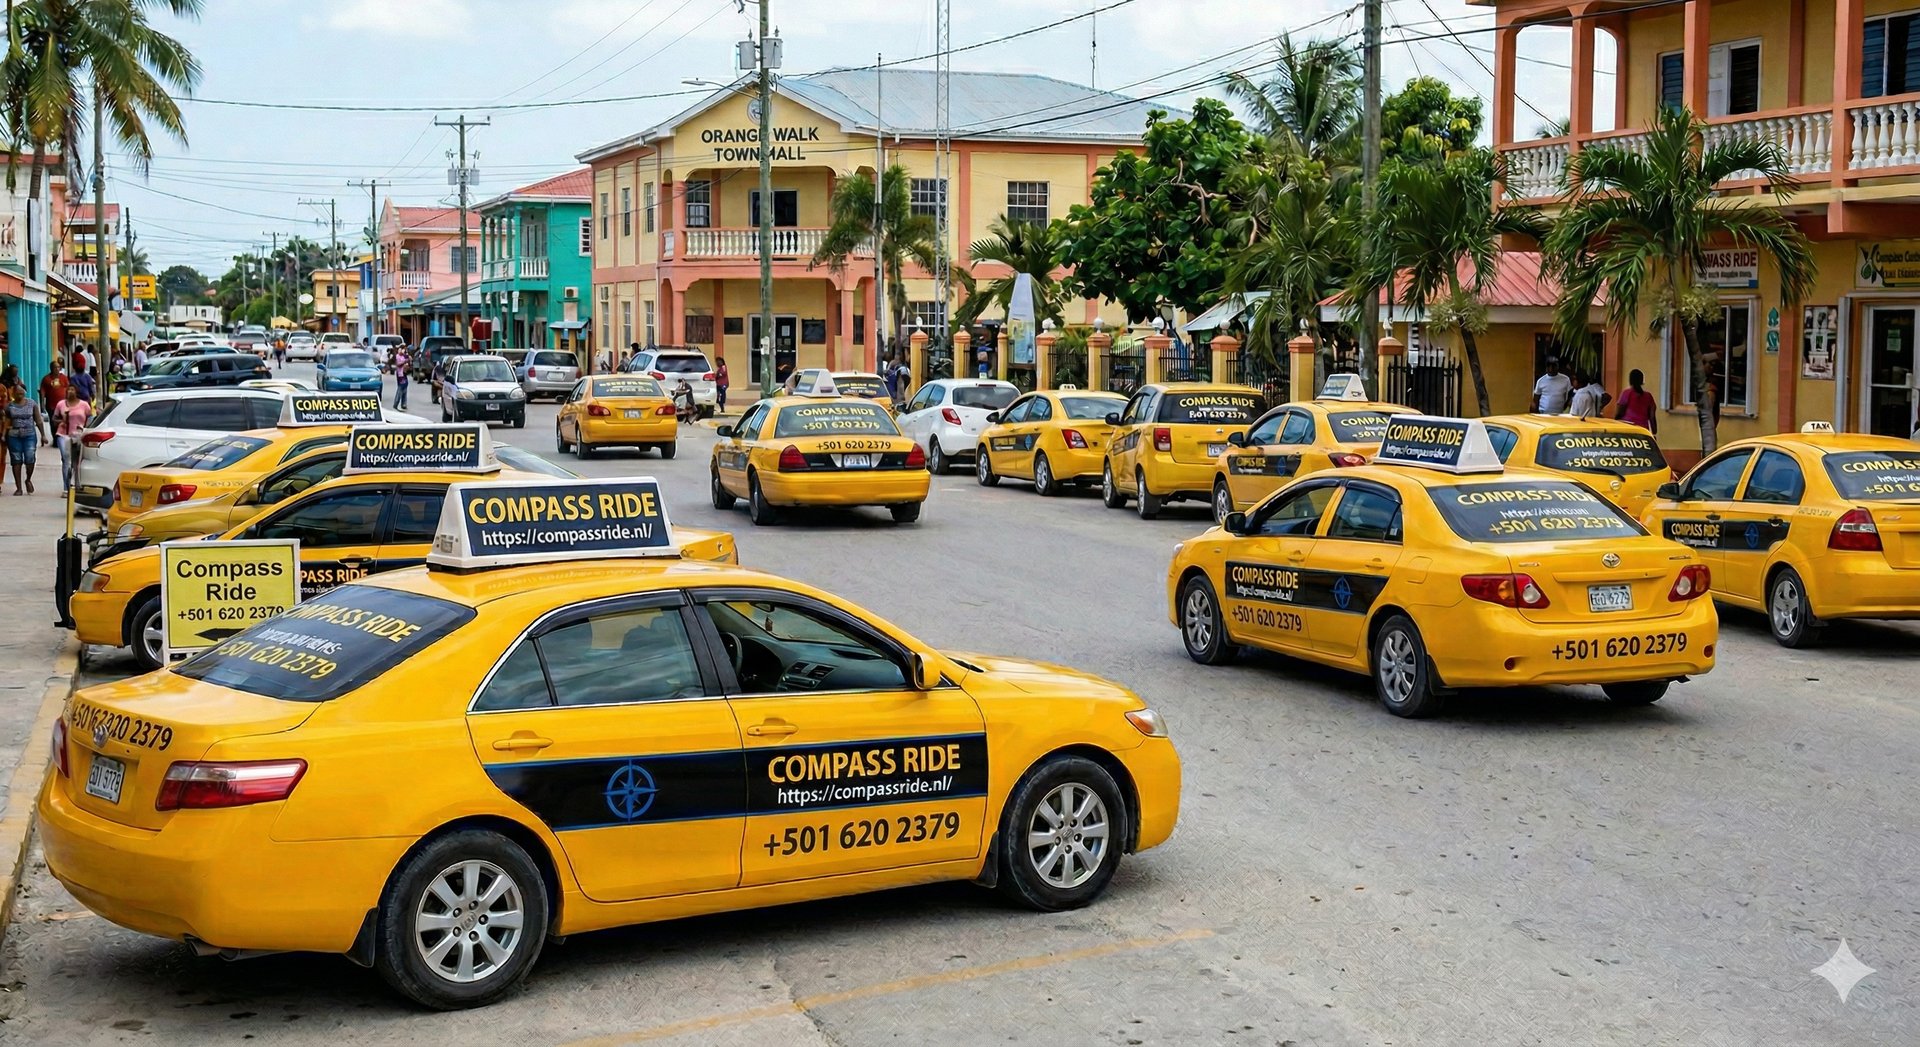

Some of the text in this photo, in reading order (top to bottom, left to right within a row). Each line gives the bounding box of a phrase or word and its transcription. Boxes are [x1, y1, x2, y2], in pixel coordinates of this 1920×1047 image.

[773, 127, 819, 141] WALK
[714, 147, 760, 162] TOWN
[1733, 252, 1757, 267] RIDE
[296, 399, 378, 411] COMPASS RIDE
[1180, 396, 1255, 408] COMPASS RIDE
[796, 407, 850, 417] COMPASS
[1209, 411, 1224, 419] 620
[802, 421, 828, 430] +501
[832, 421, 852, 429] 620
[355, 433, 475, 450] COMPASS RIDE
[1387, 424, 1464, 446] COMPASS RIDE
[1555, 437, 1651, 450] COMPASS RIDE
[816, 441, 891, 450] +501 620 2379
[360, 452, 470, 465] https://compassride.nl/
[1565, 458, 1652, 467] +501 620 2379
[1457, 490, 1552, 506] COMPASS
[468, 492, 658, 525] COMPASS RIDE
[1489, 517, 1624, 535] +501 620 2379
[482, 523, 652, 548] https://compassride.nl/
[177, 560, 283, 581] Compass
[300, 569, 333, 583] PASS
[1232, 566, 1299, 589] COMPASS RIDE
[206, 583, 256, 601] Ride
[178, 608, 212, 620] +501
[219, 607, 244, 620] 620
[1232, 605, 1302, 631] +501 620 2379
[359, 614, 422, 643] RIDE
[1552, 633, 1687, 660] +501 620 2379
[250, 643, 292, 665] 620
[284, 653, 337, 679] 2379
[129, 720, 173, 751] 2379
[768, 744, 961, 784] COMPASS RIDE
[777, 775, 953, 807] https://compassride.nl/
[763, 811, 961, 857] +501 620 2379
